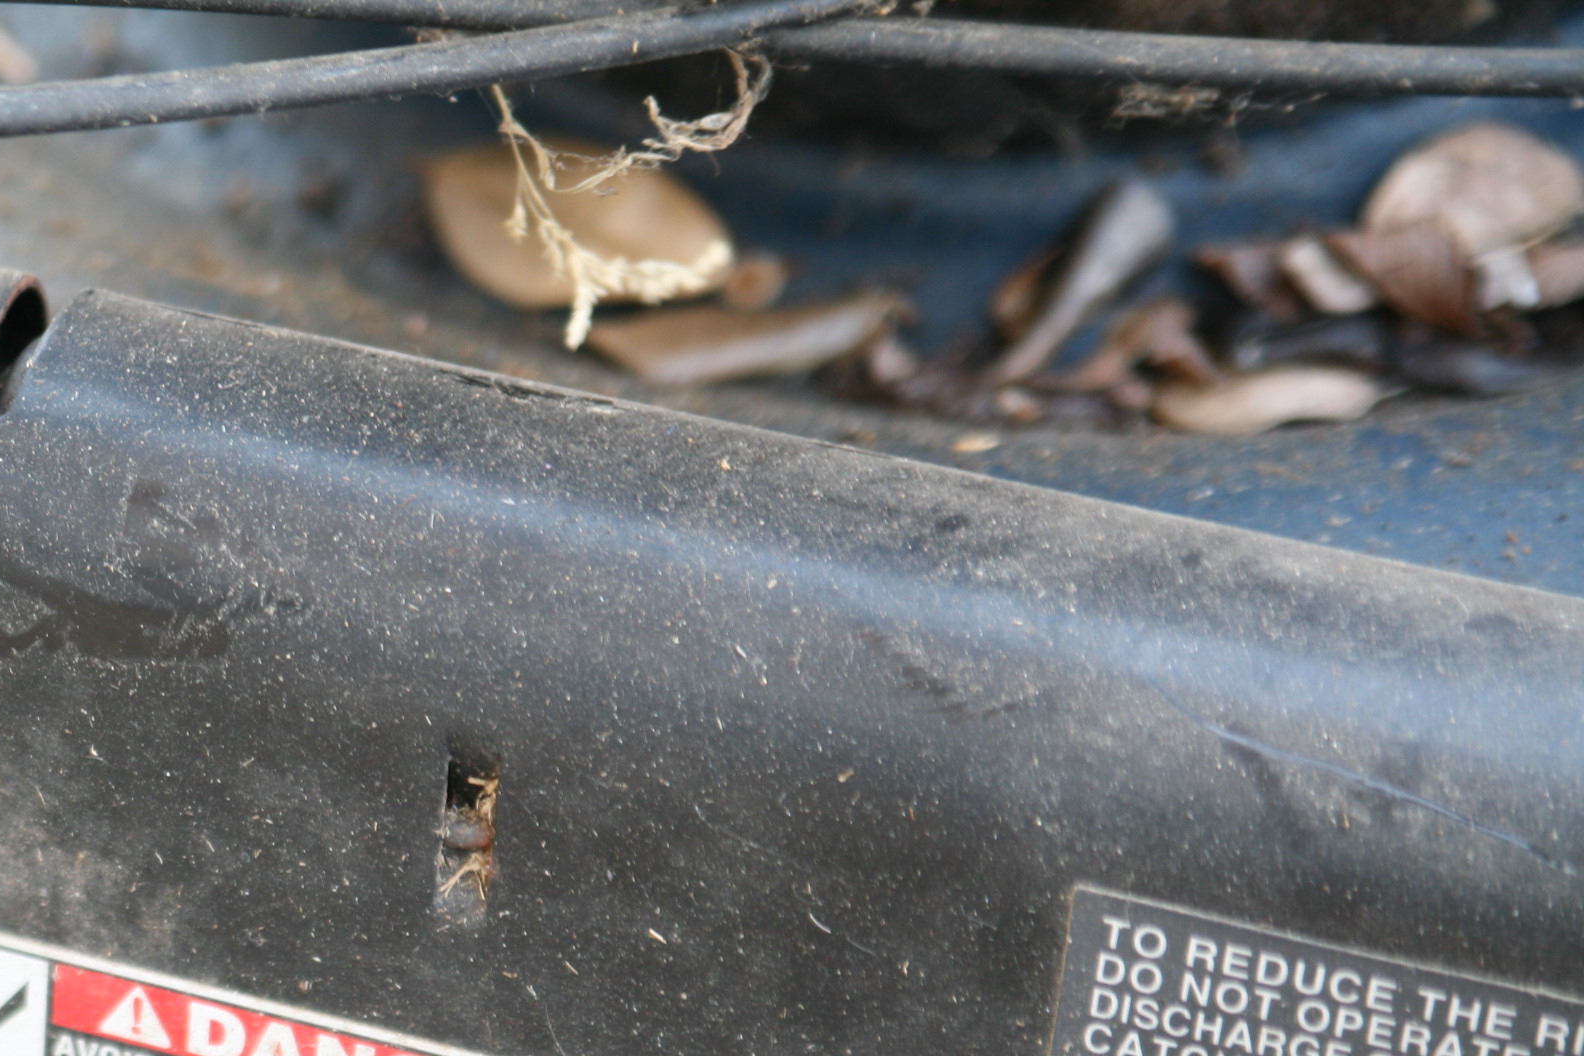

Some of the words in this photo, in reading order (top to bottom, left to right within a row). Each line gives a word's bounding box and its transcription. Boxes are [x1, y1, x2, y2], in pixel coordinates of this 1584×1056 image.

[1096, 951, 1162, 994] DO
[1181, 970, 1281, 1020] NOT
[1103, 915, 1167, 959] TO
[1186, 935, 1396, 1013] REDUCE
[1418, 986, 1517, 1040] THE
